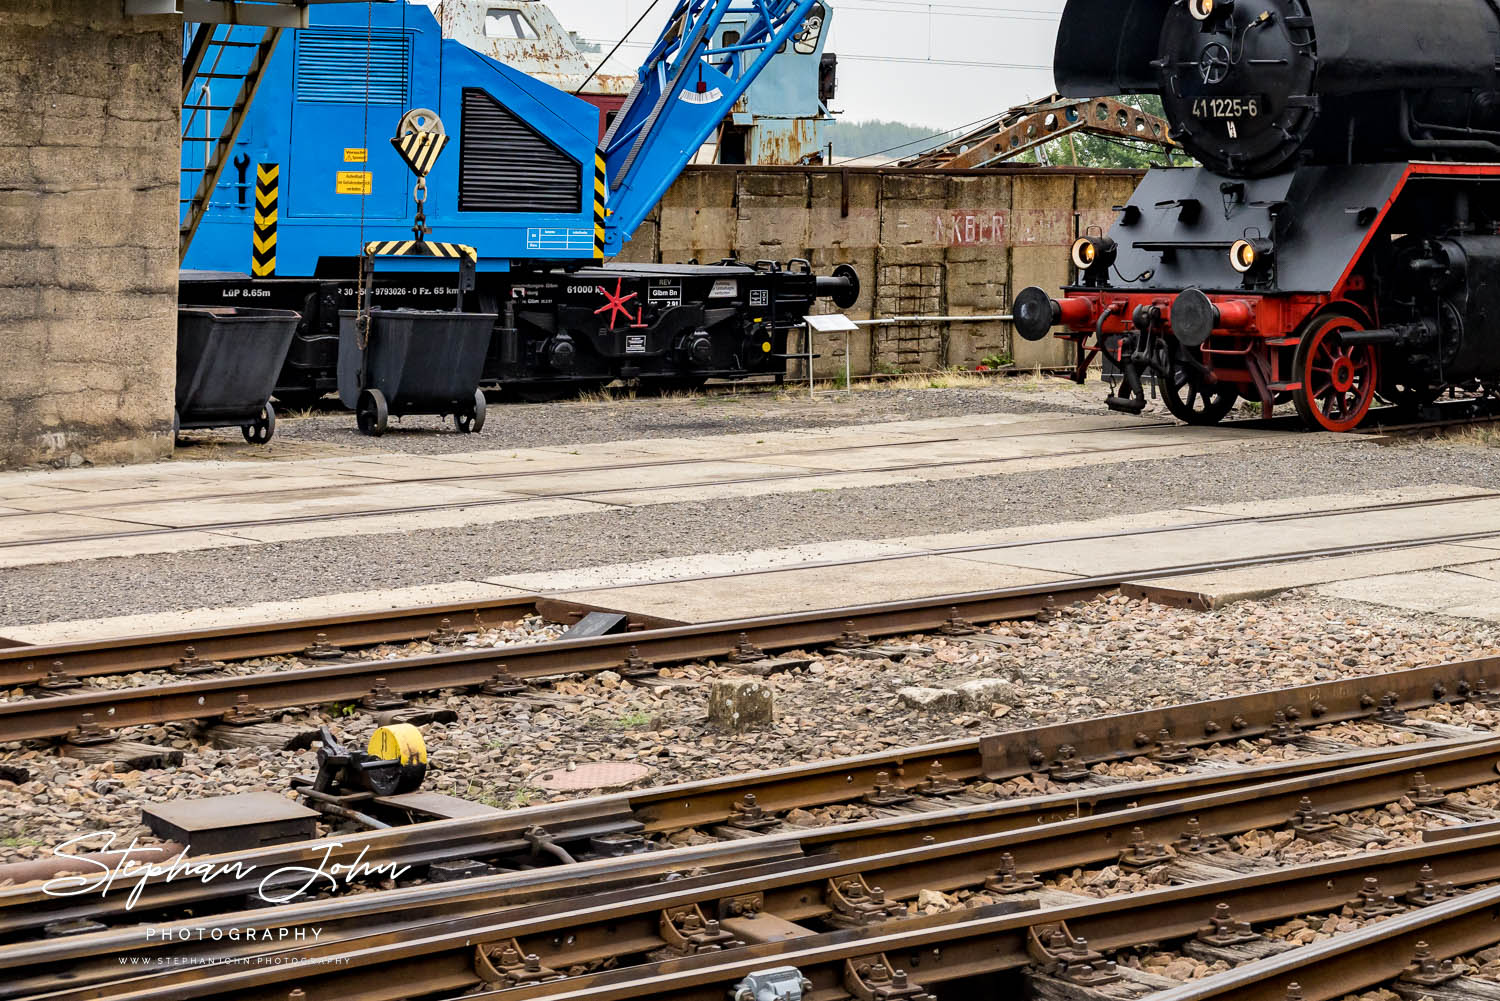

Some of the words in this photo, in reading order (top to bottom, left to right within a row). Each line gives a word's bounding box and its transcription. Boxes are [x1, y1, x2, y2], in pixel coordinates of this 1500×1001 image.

[1192, 99, 1208, 117] 41
[1210, 98, 1258, 117] 1225-6
[222, 289, 240, 297] LüP
[242, 289, 271, 297] 8.65m
[343, 288, 354, 296] 30
[375, 287, 406, 296] 9793026
[412, 287, 417, 295] 0
[419, 287, 431, 295] Fz.
[433, 286, 444, 294] 65
[566, 285, 593, 294] 61000
